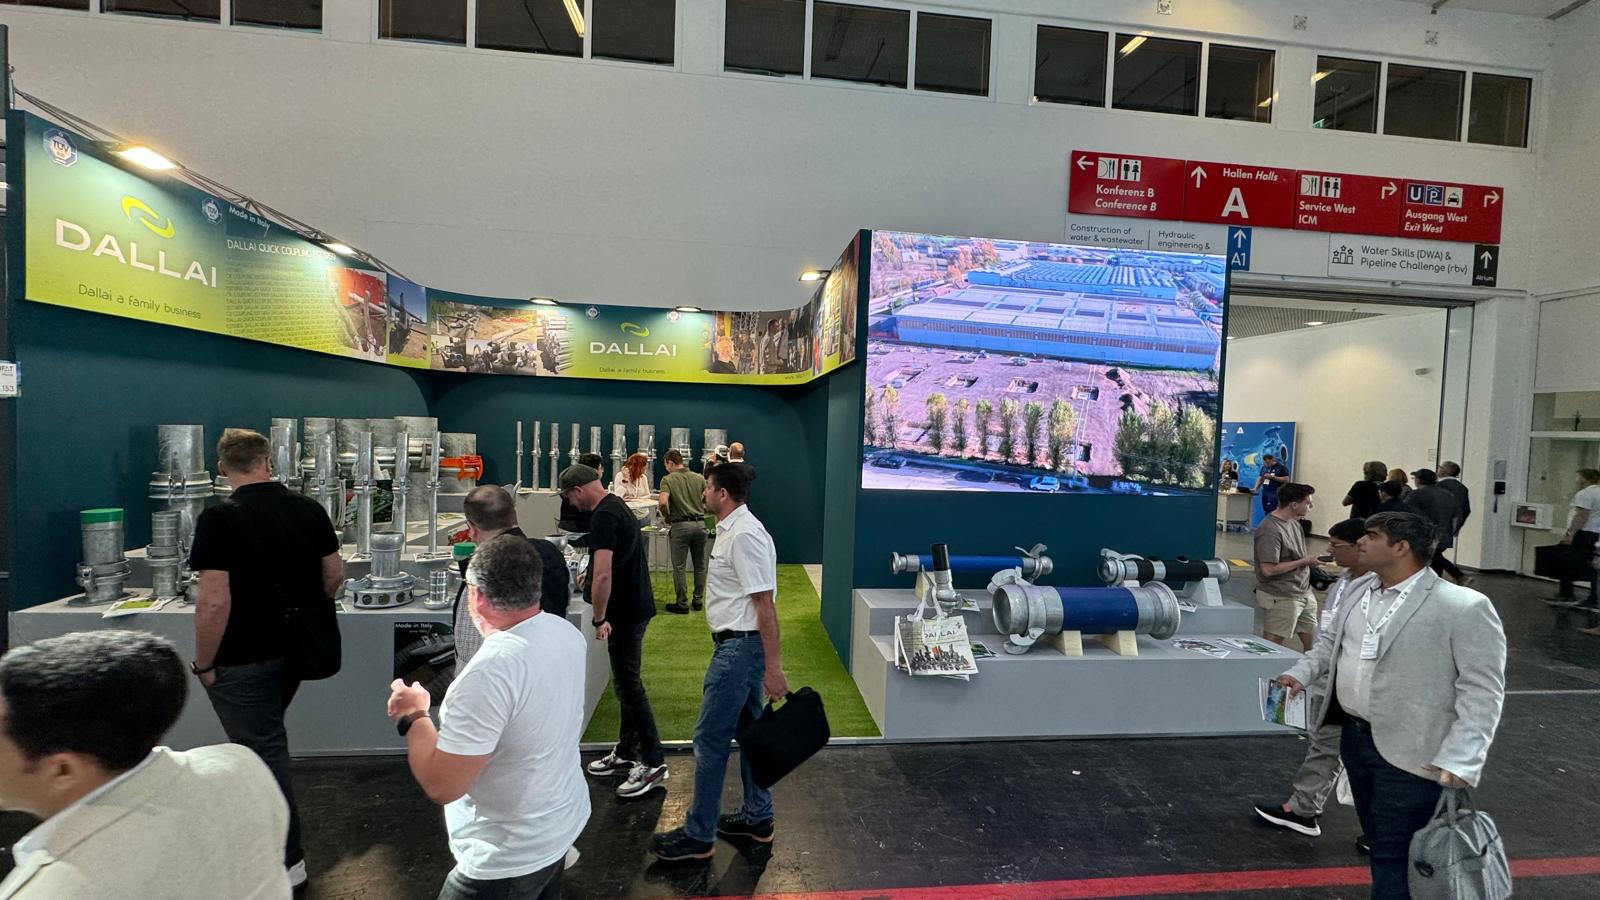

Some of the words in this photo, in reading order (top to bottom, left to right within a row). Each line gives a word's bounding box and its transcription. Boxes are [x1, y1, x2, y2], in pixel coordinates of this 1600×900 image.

[1222, 167, 1253, 180] Hallen
[1255, 170, 1279, 182] Halls
[1096, 184, 1145, 197] Konferenz
[1147, 188, 1155, 198] B
[1410, 186, 1422, 200] U
[1095, 198, 1148, 212] Conference
[1149, 202, 1157, 212] B
[1220, 187, 1249, 219] A
[1299, 200, 1332, 213] Service
[1334, 203, 1356, 214] West
[228, 205, 249, 220] Made
[1298, 214, 1318, 225] ICM
[1404, 209, 1445, 223] Ausgang
[1446, 212, 1468, 223] West
[1070, 223, 1121, 234] Construction
[1123, 227, 1132, 235] of
[1404, 222, 1421, 233] Exit
[1422, 224, 1443, 234] West
[1070, 234, 1091, 242] water
[1101, 236, 1144, 245] wastewater
[1158, 230, 1196, 241] Hydraulic
[227, 239, 257, 252] DALLAI
[1157, 240, 1204, 250] engineering
[55, 217, 217, 288] DALLAI
[1231, 252, 1246, 267] A1
[1360, 244, 1388, 255] Water
[1391, 246, 1415, 258] Skills
[1416, 248, 1443, 261] (DWA)
[1444, 251, 1452, 260] &
[1360, 257, 1398, 271] Pipeline
[1399, 260, 1446, 273] Challenge
[1446, 263, 1468, 275] (rbv)
[78, 283, 113, 302] Dallai
[116, 294, 125, 304] a
[128, 295, 161, 313] family
[163, 302, 202, 320] business
[589, 341, 677, 357] DALLAI
